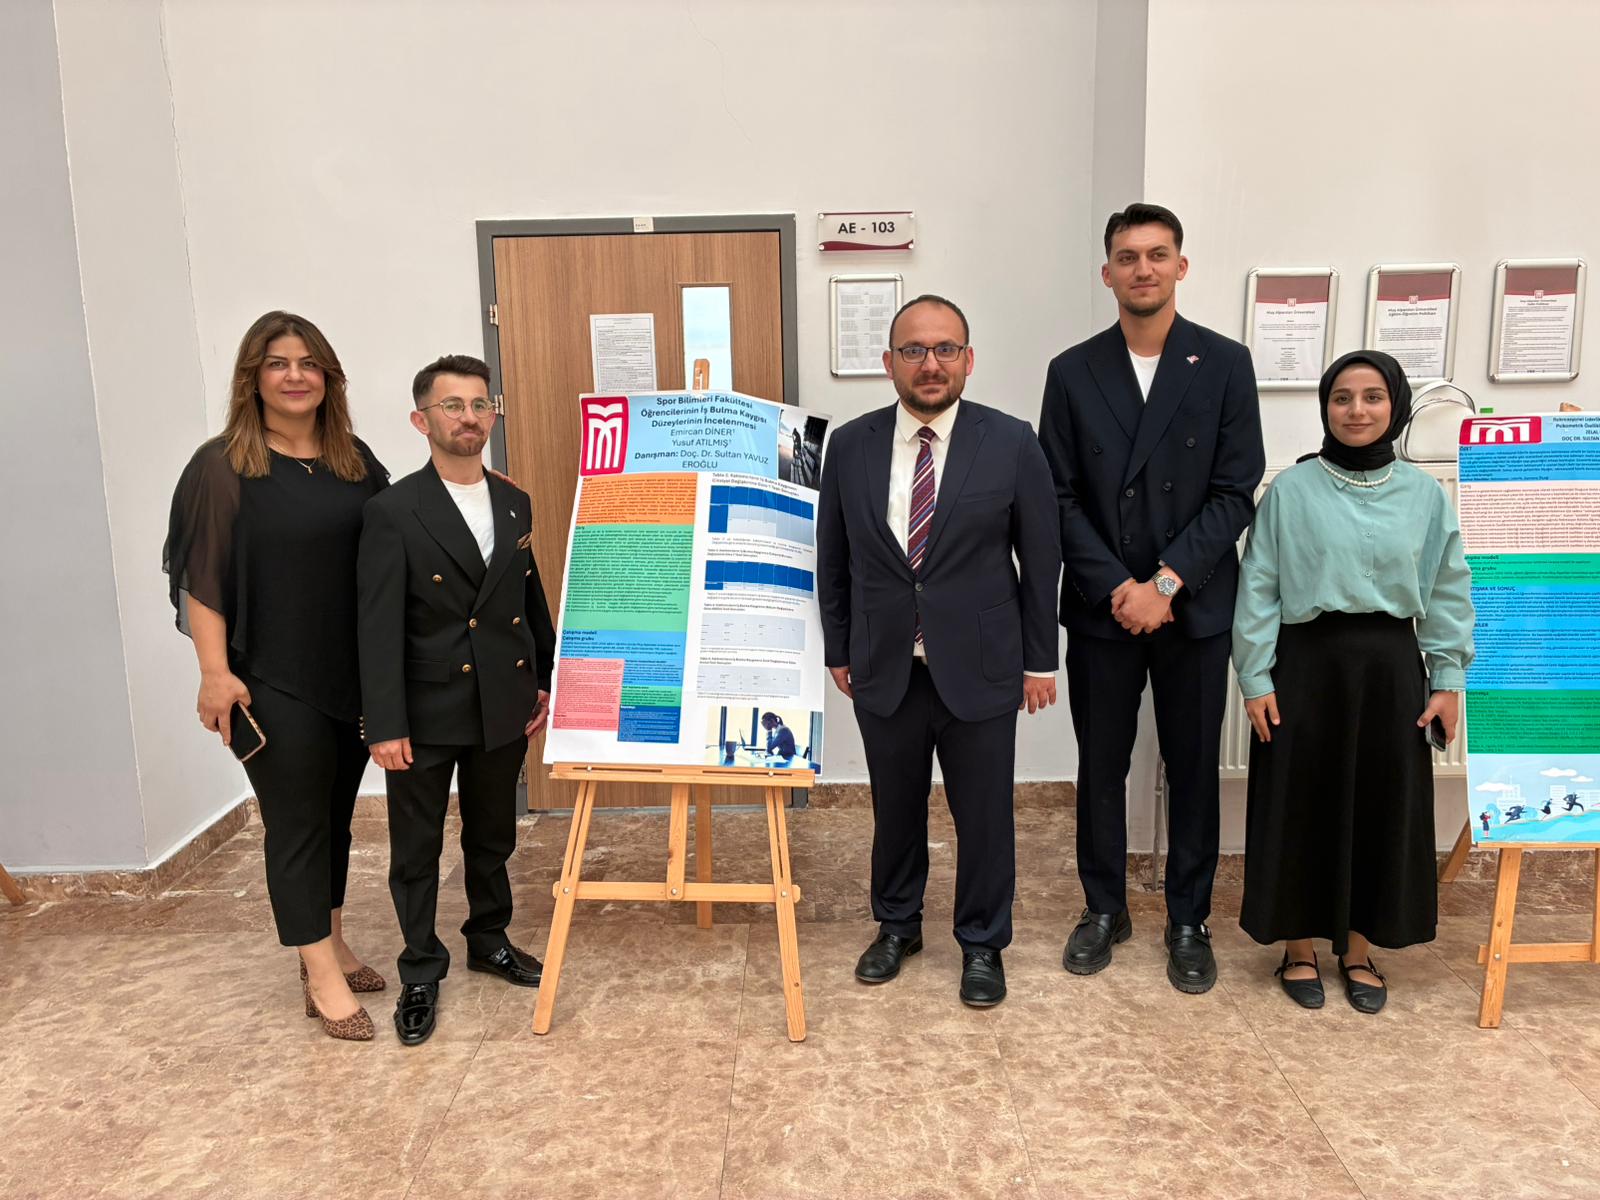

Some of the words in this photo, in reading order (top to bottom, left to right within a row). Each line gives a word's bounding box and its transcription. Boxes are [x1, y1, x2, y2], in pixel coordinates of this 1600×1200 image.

[838, 222, 856, 234] AE
[872, 222, 895, 233] 103
[656, 398, 675, 406] Spor
[678, 396, 712, 404] Bilimleri
[715, 395, 753, 408] Fakültesi
[641, 408, 698, 418] Öğrencilerinin
[701, 406, 707, 415] İş
[710, 406, 738, 415] Bulma
[740, 410, 767, 424] Kaygısı
[652, 418, 702, 428] Düzeylerinin
[704, 416, 757, 430] İncelenmesi
[634, 451, 678, 459] Danışman:
[680, 450, 698, 458] Doç.
[714, 450, 741, 458] Sultan
[744, 453, 768, 464] YAVUZ
[682, 460, 718, 468] EROĞLU
